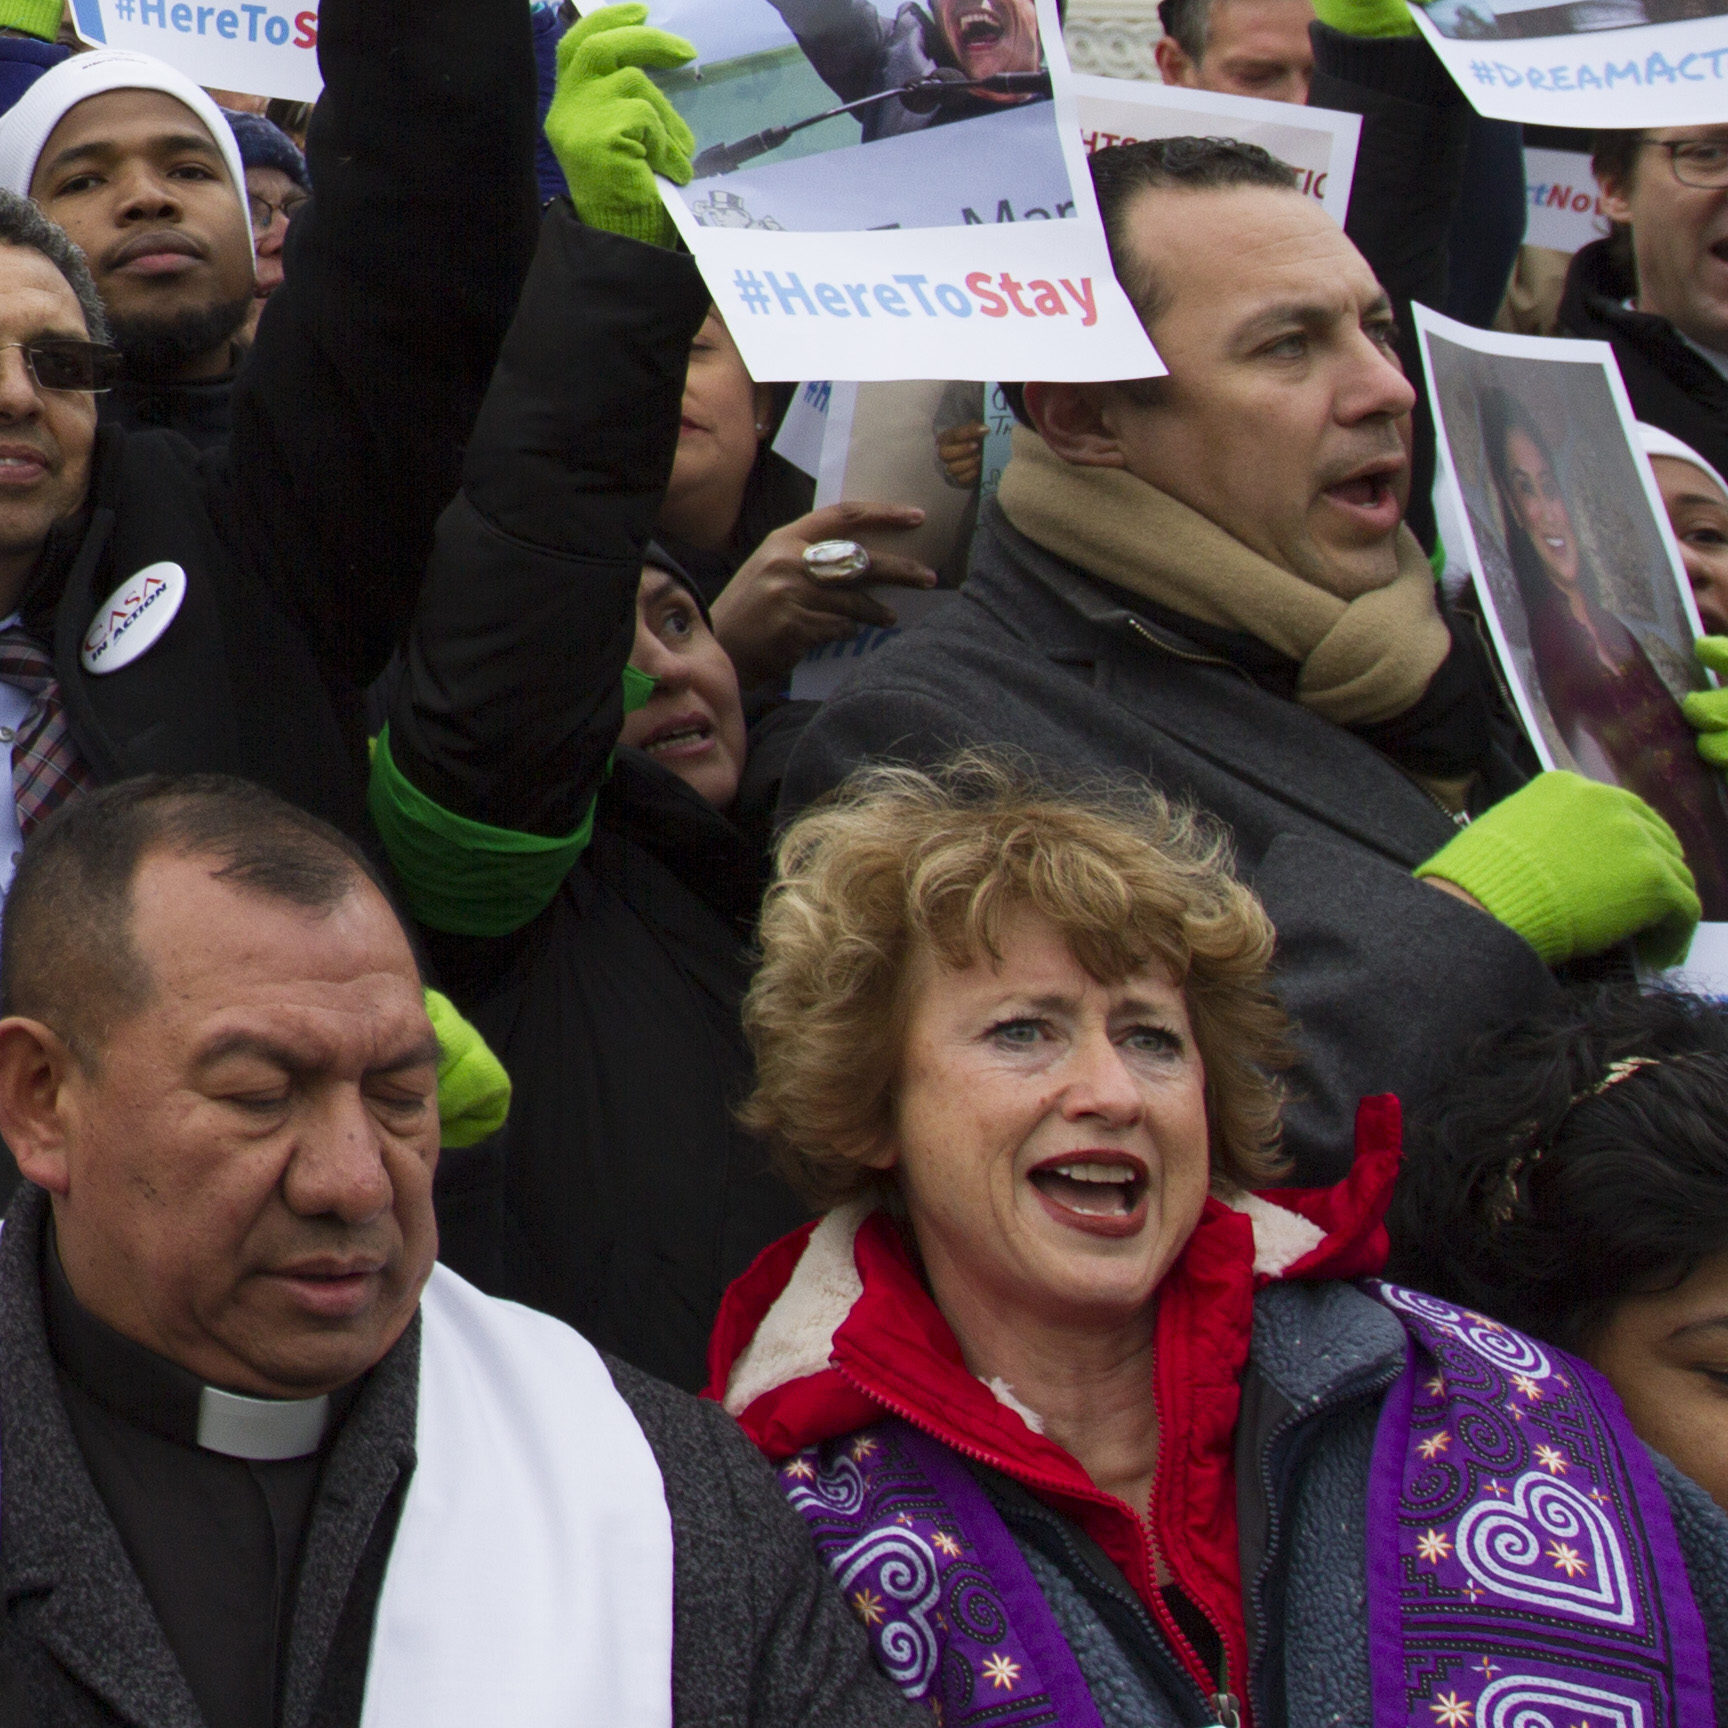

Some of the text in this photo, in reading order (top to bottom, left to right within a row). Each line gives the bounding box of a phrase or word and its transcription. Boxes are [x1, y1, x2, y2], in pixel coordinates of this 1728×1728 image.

[1468, 47, 1728, 91] #DREAMACT
[733, 269, 1099, 328] #HereToStay
[84, 577, 164, 653] CASA
[91, 582, 168, 662] IN ACTION
